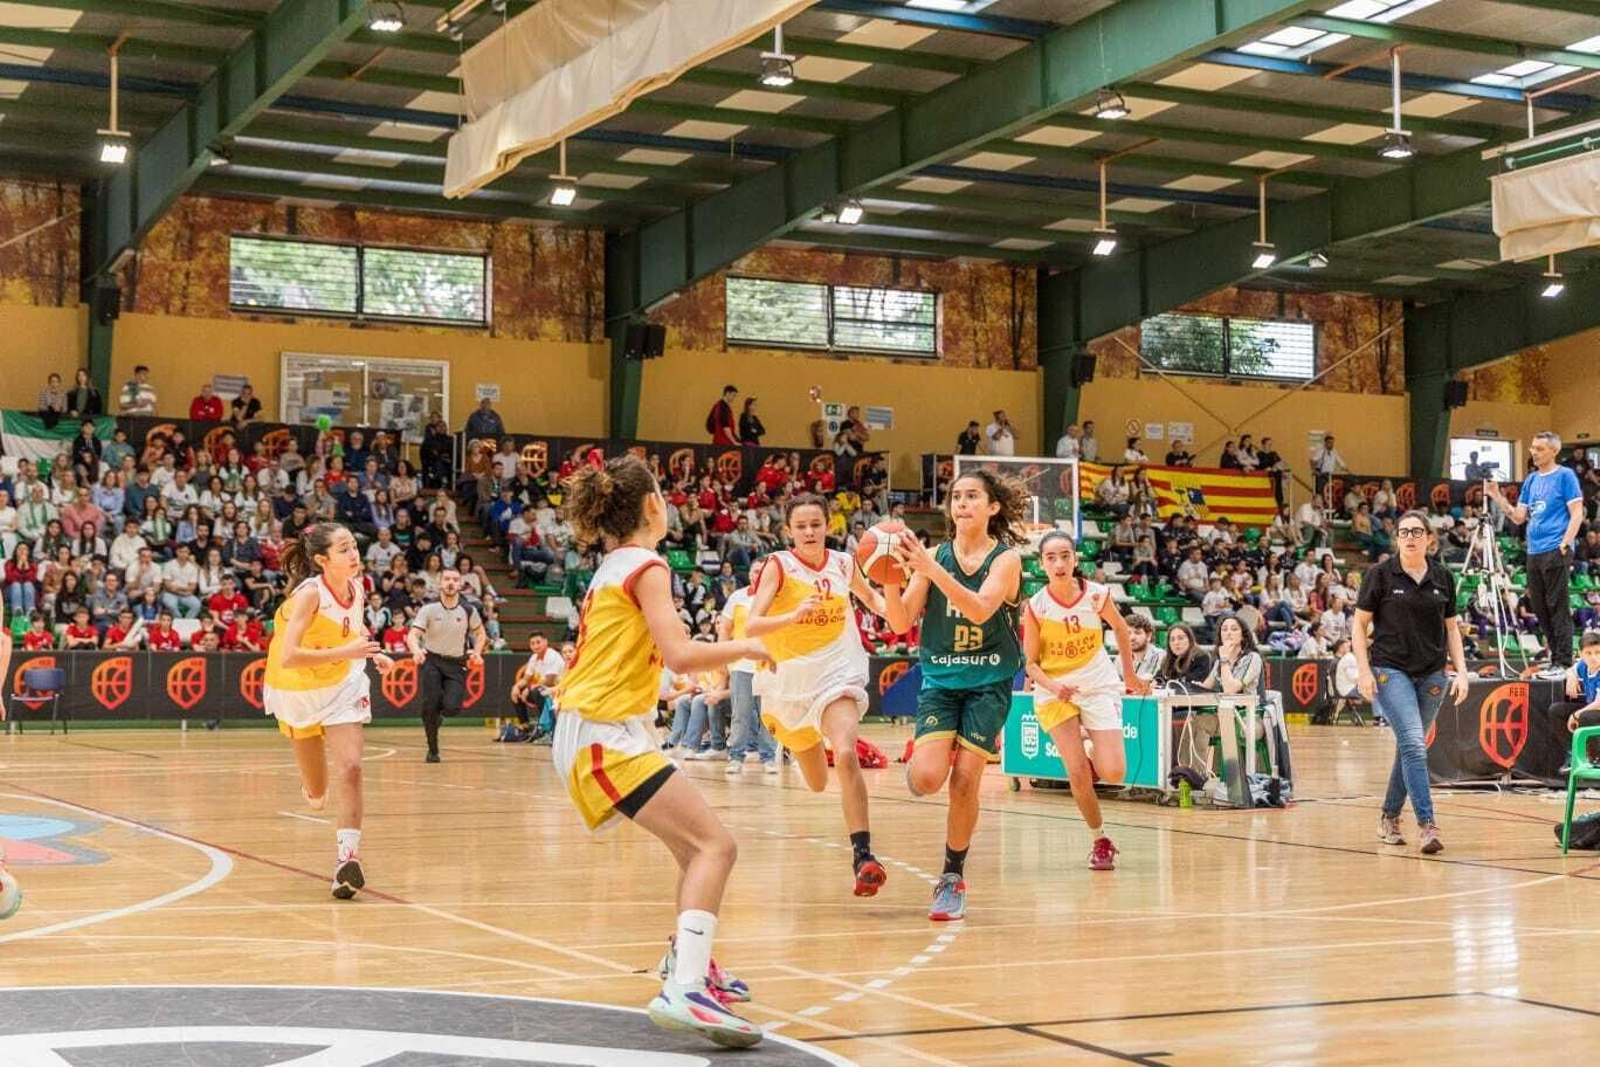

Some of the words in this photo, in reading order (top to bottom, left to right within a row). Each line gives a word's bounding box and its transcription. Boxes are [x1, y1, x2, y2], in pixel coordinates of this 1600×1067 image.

[813, 578, 834, 600] 12
[342, 616, 350, 638] 8
[1063, 615, 1081, 634] 13
[954, 625, 983, 653] 23
[931, 654, 988, 667] cajasur
